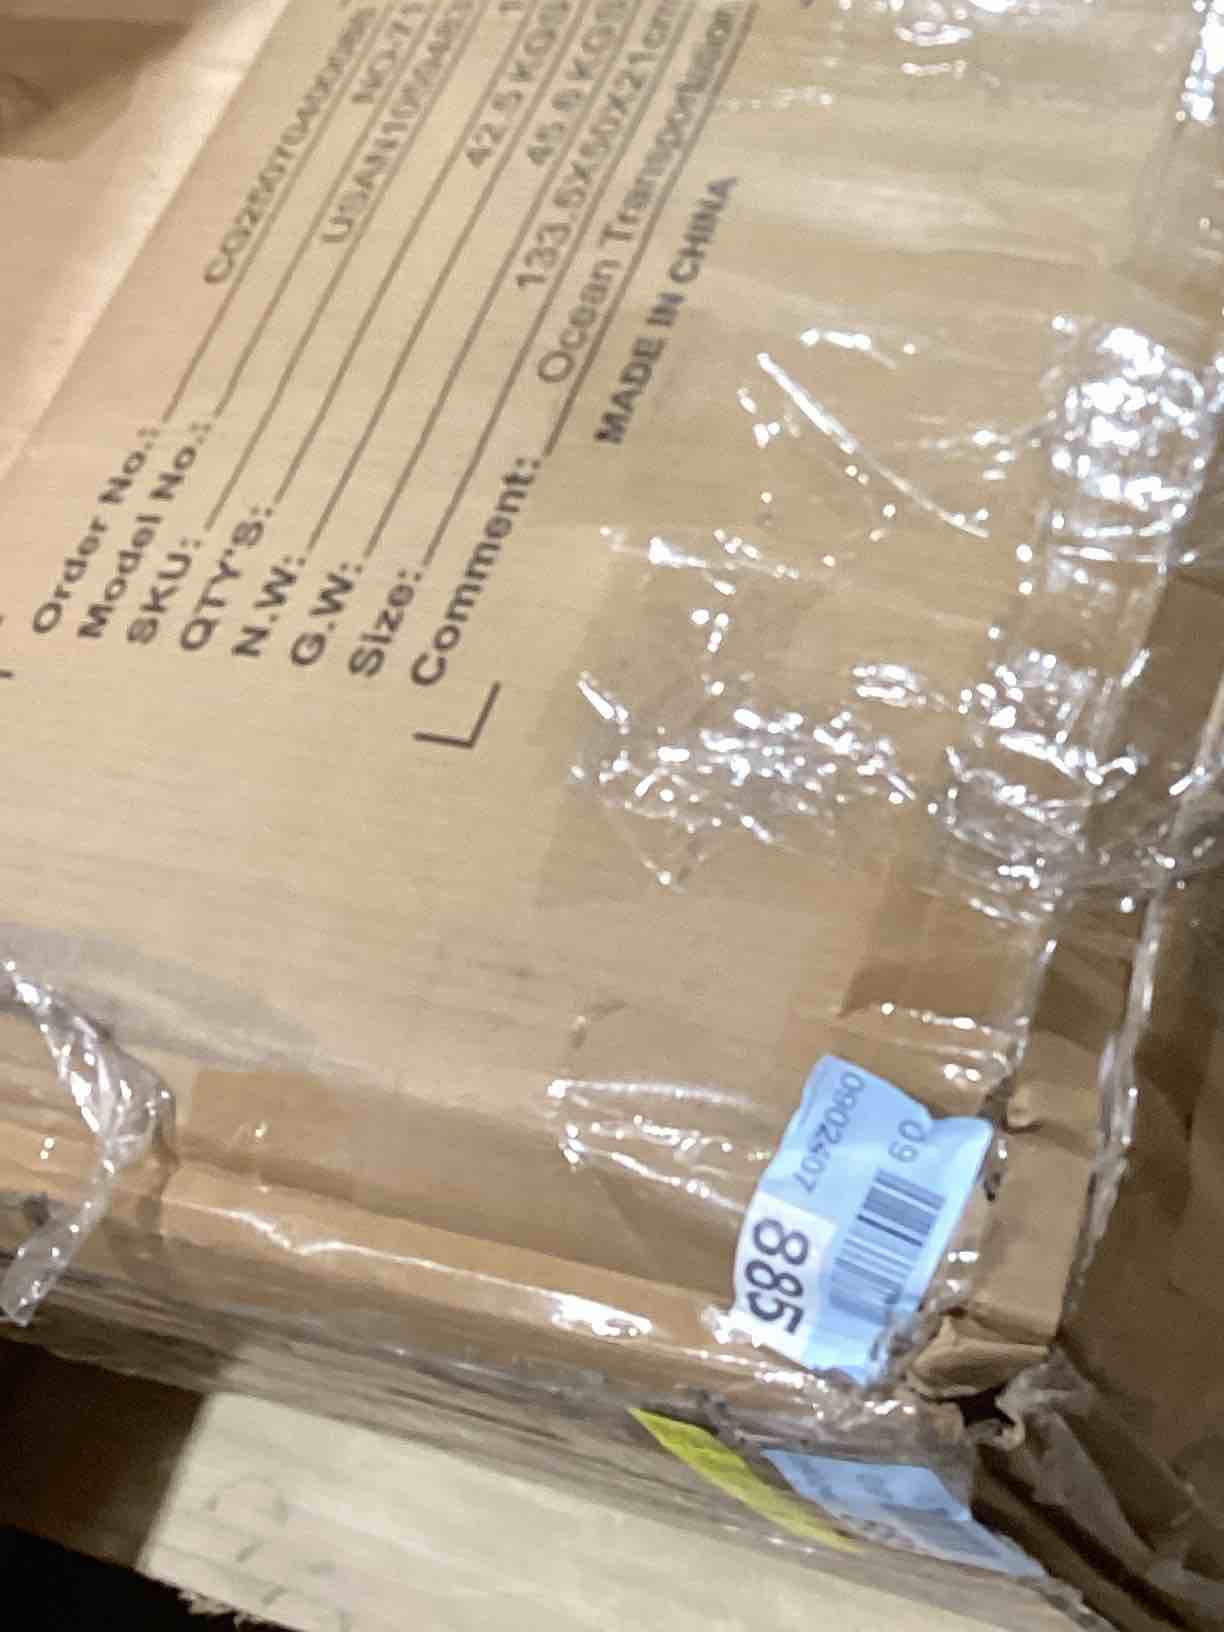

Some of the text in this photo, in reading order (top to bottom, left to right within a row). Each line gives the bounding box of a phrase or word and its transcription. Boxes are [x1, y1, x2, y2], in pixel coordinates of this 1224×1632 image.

[498, 0, 526, 16] 1
[577, 0, 630, 80] KGS
[466, 0, 570, 166] 42.5 KGS
[537, 260, 620, 383] Ocean
[594, 179, 740, 444] MADE IN CHINA
[33, 426, 160, 634] Order No.:
[76, 422, 214, 639] Model No.:
[180, 506, 275, 651] QTY'S:
[410, 458, 543, 686] Comment:
[127, 536, 203, 645] SKU:
[230, 557, 307, 658] N.W:
[290, 564, 364, 667] G.W:
[348, 571, 425, 678] Size:
[887, 1118, 925, 1163] 09
[744, 1219, 809, 1333] 885
